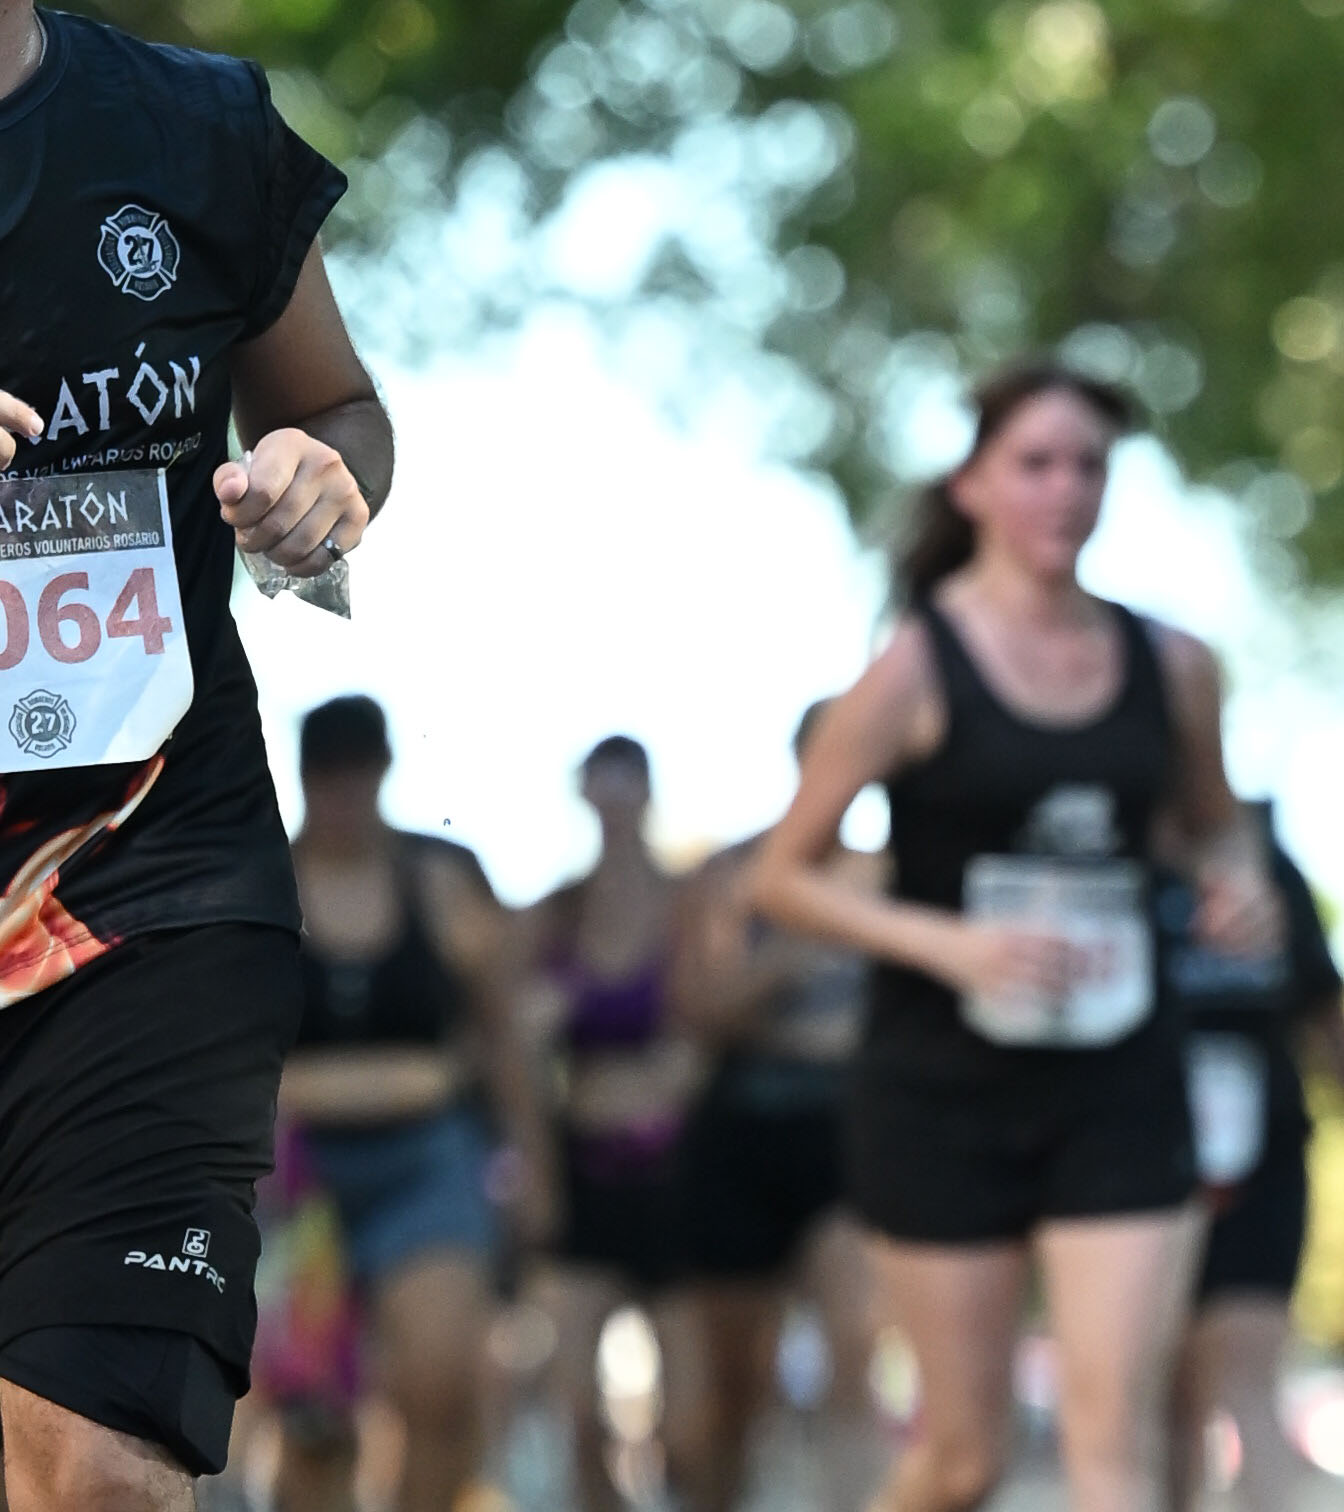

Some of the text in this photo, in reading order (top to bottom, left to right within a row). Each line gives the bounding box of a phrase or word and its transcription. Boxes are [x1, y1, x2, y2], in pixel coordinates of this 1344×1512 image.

[35, 535, 111, 555] VOLUNTARIOS
[113, 531, 160, 548] ROSARIO
[30, 711, 56, 735] 27
